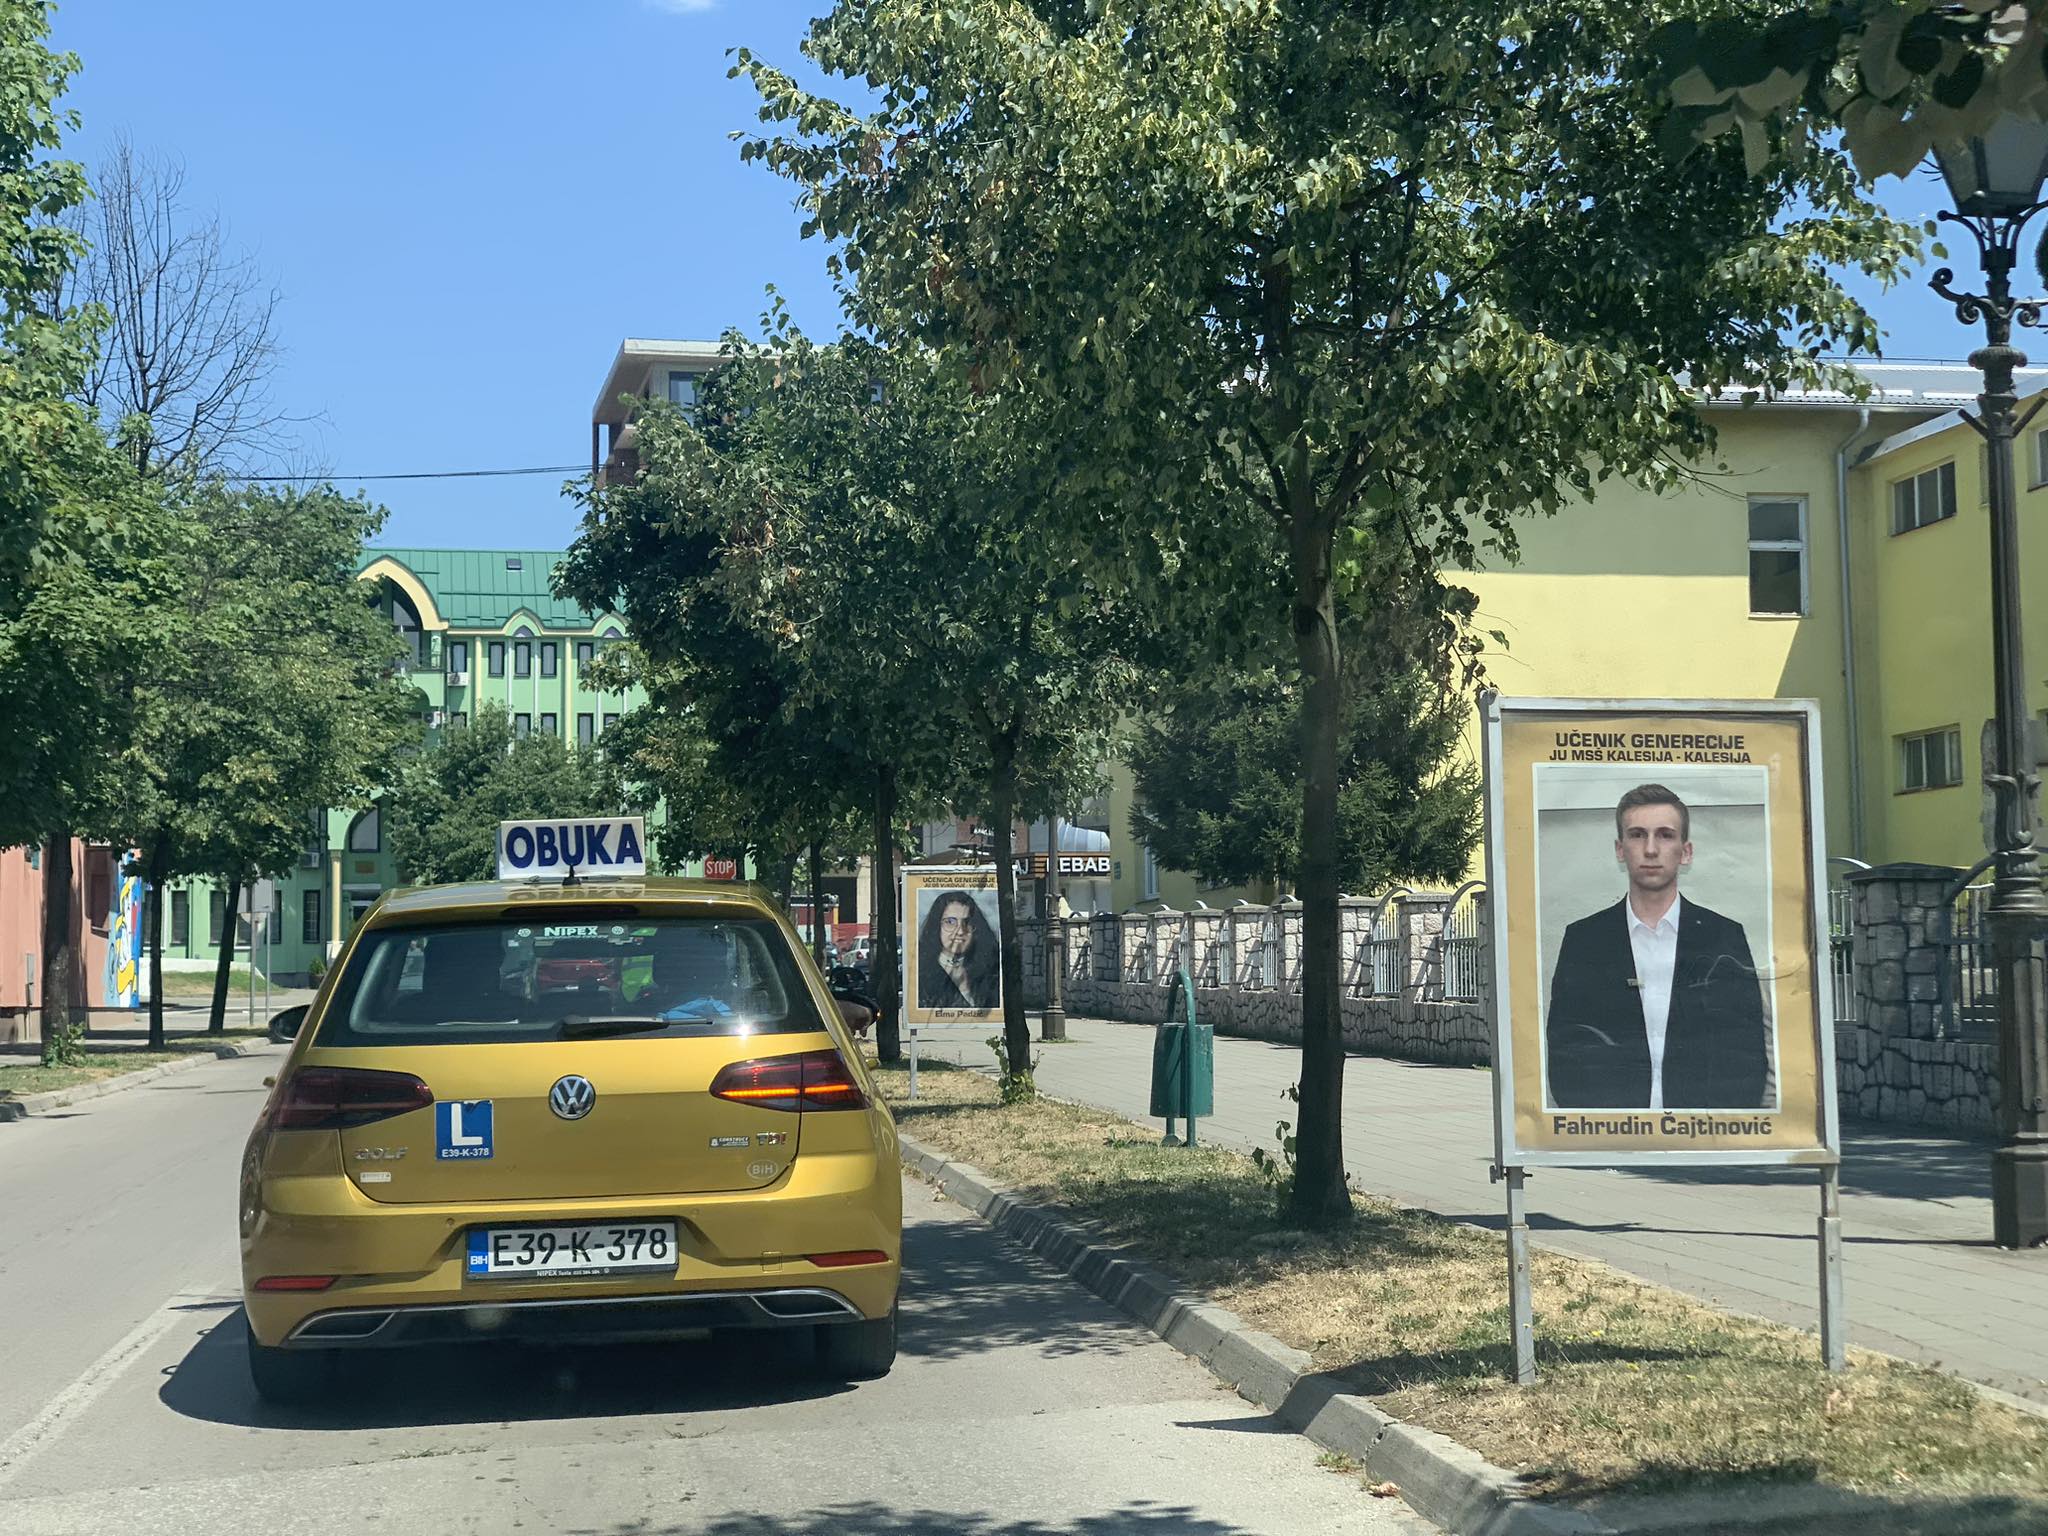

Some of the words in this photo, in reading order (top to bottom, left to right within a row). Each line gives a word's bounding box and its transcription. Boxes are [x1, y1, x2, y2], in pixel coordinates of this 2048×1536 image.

[1555, 730, 1626, 748] UČENIK
[1631, 733, 1745, 750] GENERECIJE
[1550, 750, 1567, 761] JU
[1571, 748, 1603, 761] MSŠ
[1607, 751, 1673, 762] KALESIJA
[1684, 751, 1751, 763] KALESIJA
[505, 824, 643, 869] OBUKA
[706, 861, 734, 874] STOP
[544, 926, 599, 937] NIPEX
[451, 1102, 483, 1146] L
[1553, 1115, 1653, 1136] Fahrudin
[1660, 1111, 1772, 1139] Čajtinović
[442, 1148, 490, 1158] E39-K-378
[493, 1228, 668, 1267] E39-K-378
[470, 1255, 488, 1265] BIH
